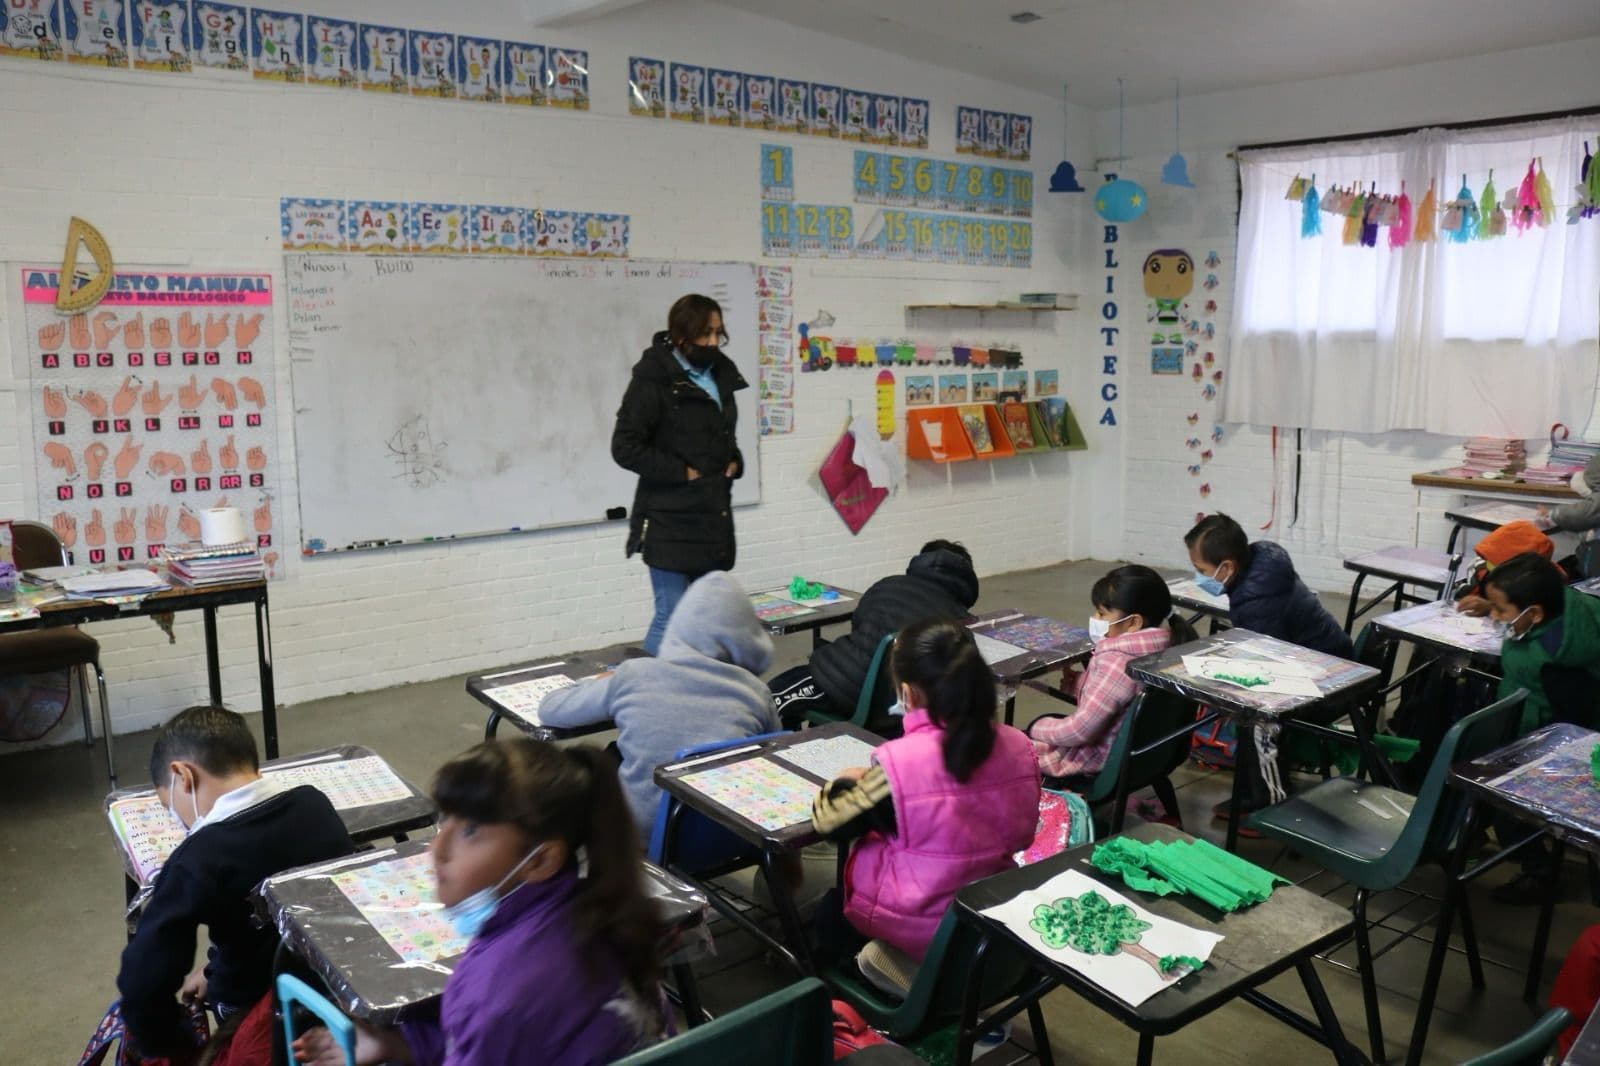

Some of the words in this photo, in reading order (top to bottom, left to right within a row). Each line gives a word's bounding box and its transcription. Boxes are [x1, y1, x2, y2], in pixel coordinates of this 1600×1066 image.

[83, 1, 94, 16] E
[144, 8, 152, 23] F
[206, 13, 221, 28] G
[33, 21, 46, 38] d
[103, 27, 114, 39] e
[262, 22, 273, 36] H
[321, 28, 330, 43] I
[165, 36, 170, 51] f
[225, 40, 236, 54] g
[372, 37, 379, 48] J
[421, 40, 430, 54] K
[281, 48, 290, 63] h
[470, 48, 476, 61] L
[437, 65, 445, 80] k
[680, 73, 689, 84] O
[769, 150, 783, 183] 1
[860, 156, 877, 187] 4
[890, 158, 905, 190] 5
[914, 160, 932, 193] 6
[944, 164, 959, 193] 7
[967, 166, 984, 197] 8
[992, 171, 1005, 198] 9
[1013, 176, 1030, 201] 10
[361, 210, 382, 228] Aa
[422, 212, 442, 230] Ee
[763, 205, 788, 234] 11
[796, 207, 819, 236] 12
[824, 207, 852, 239] 13
[885, 213, 906, 242] 15
[912, 218, 933, 247] 16
[940, 222, 960, 246] 17
[964, 223, 984, 250] 18
[989, 223, 1007, 251] 19
[1011, 224, 1030, 250] 20
[167, 275, 268, 292] MANUAL
[1099, 174, 1118, 426] BLIOTECA
[45, 354, 57, 367] A
[77, 354, 88, 367] B
[99, 353, 111, 366] C
[130, 353, 142, 366] D
[157, 353, 169, 366] E
[184, 353, 195, 366] F
[206, 353, 218, 366] G
[240, 353, 251, 364] H
[96, 421, 105, 432] J
[115, 420, 128, 431] K
[146, 418, 158, 430] L
[180, 418, 199, 428] LL
[221, 415, 233, 427] M
[248, 414, 259, 425] N
[88, 485, 100, 498] O
[119, 484, 129, 497] P
[199, 479, 208, 490] R
[220, 477, 240, 489] RR
[251, 475, 261, 486] S
[91, 552, 103, 563] U
[121, 548, 132, 561] V
[259, 537, 269, 547] Z
